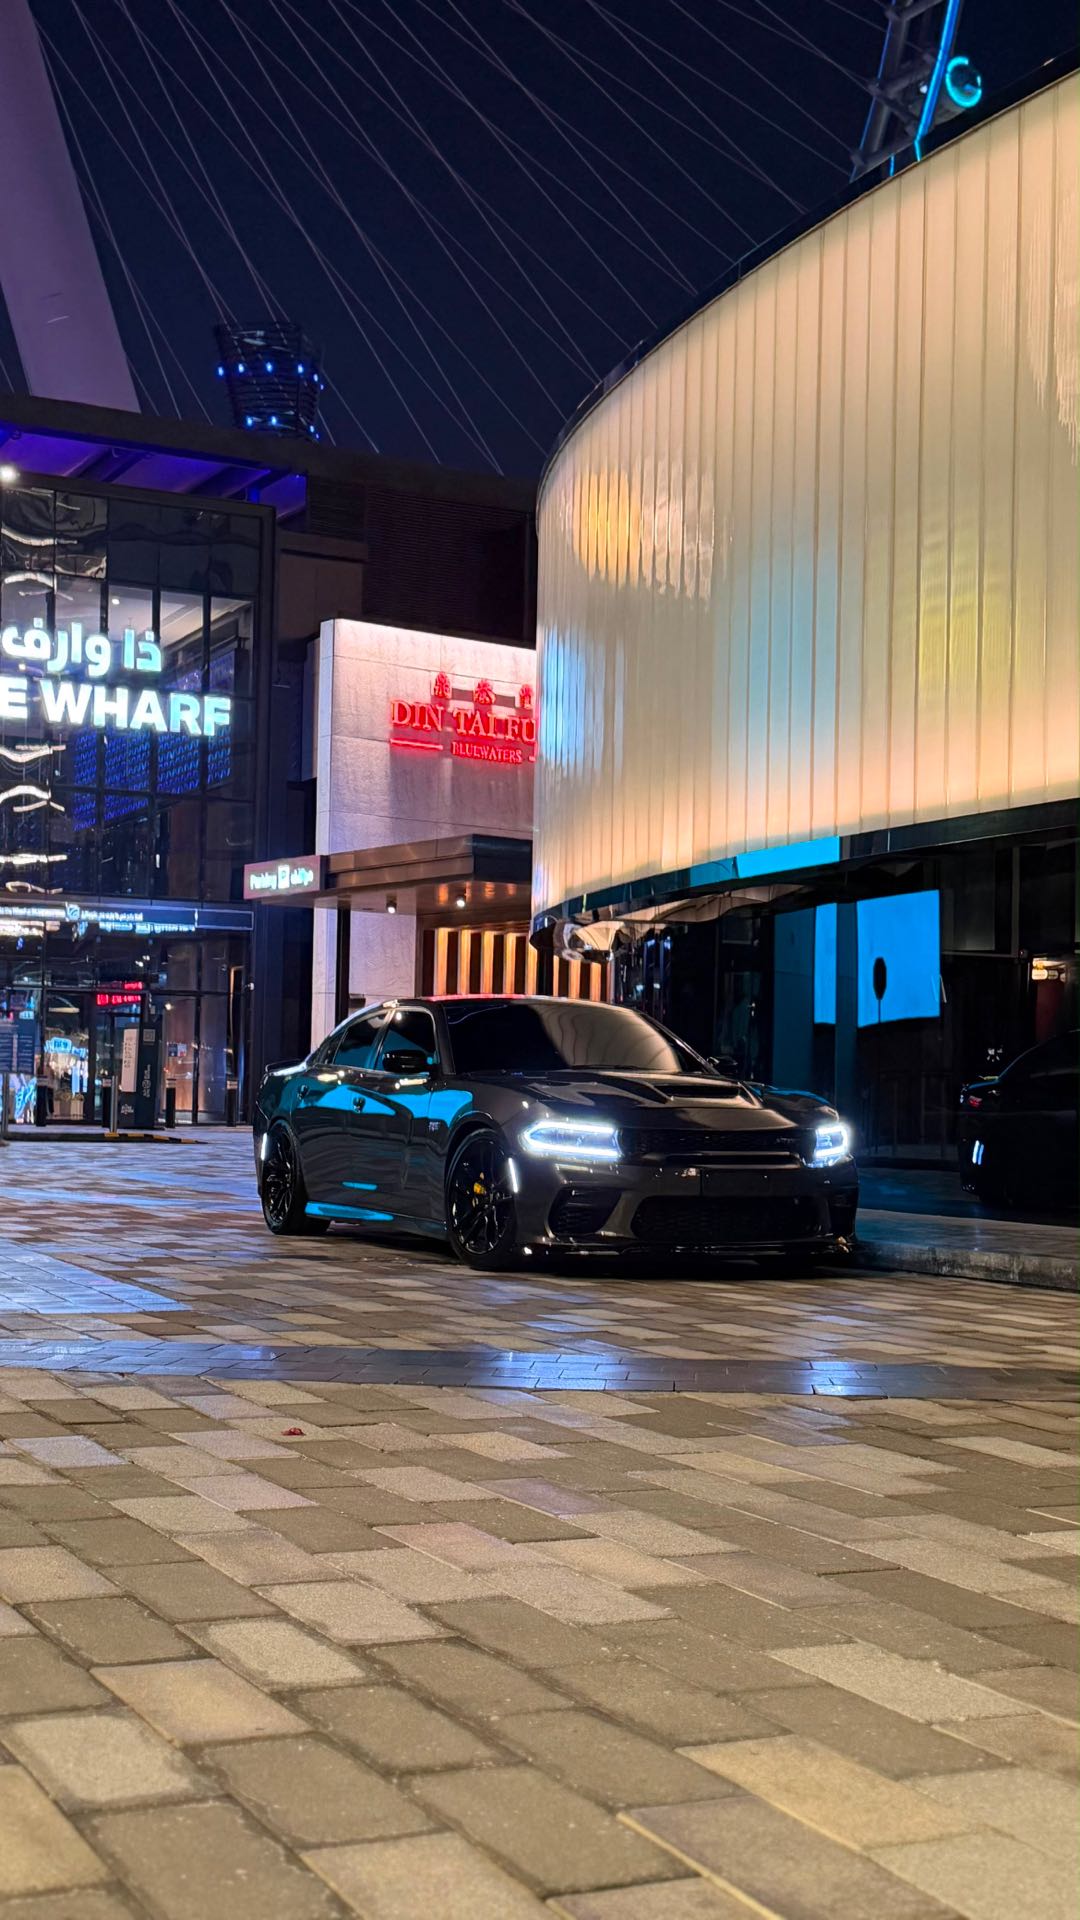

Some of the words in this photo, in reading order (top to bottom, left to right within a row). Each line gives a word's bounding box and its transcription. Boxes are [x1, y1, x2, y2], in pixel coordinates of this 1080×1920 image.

[39, 679, 231, 736] WHARF
[390, 700, 445, 732] DIN
[452, 709, 497, 738] TAI
[451, 741, 523, 763] BLUEWATERS
